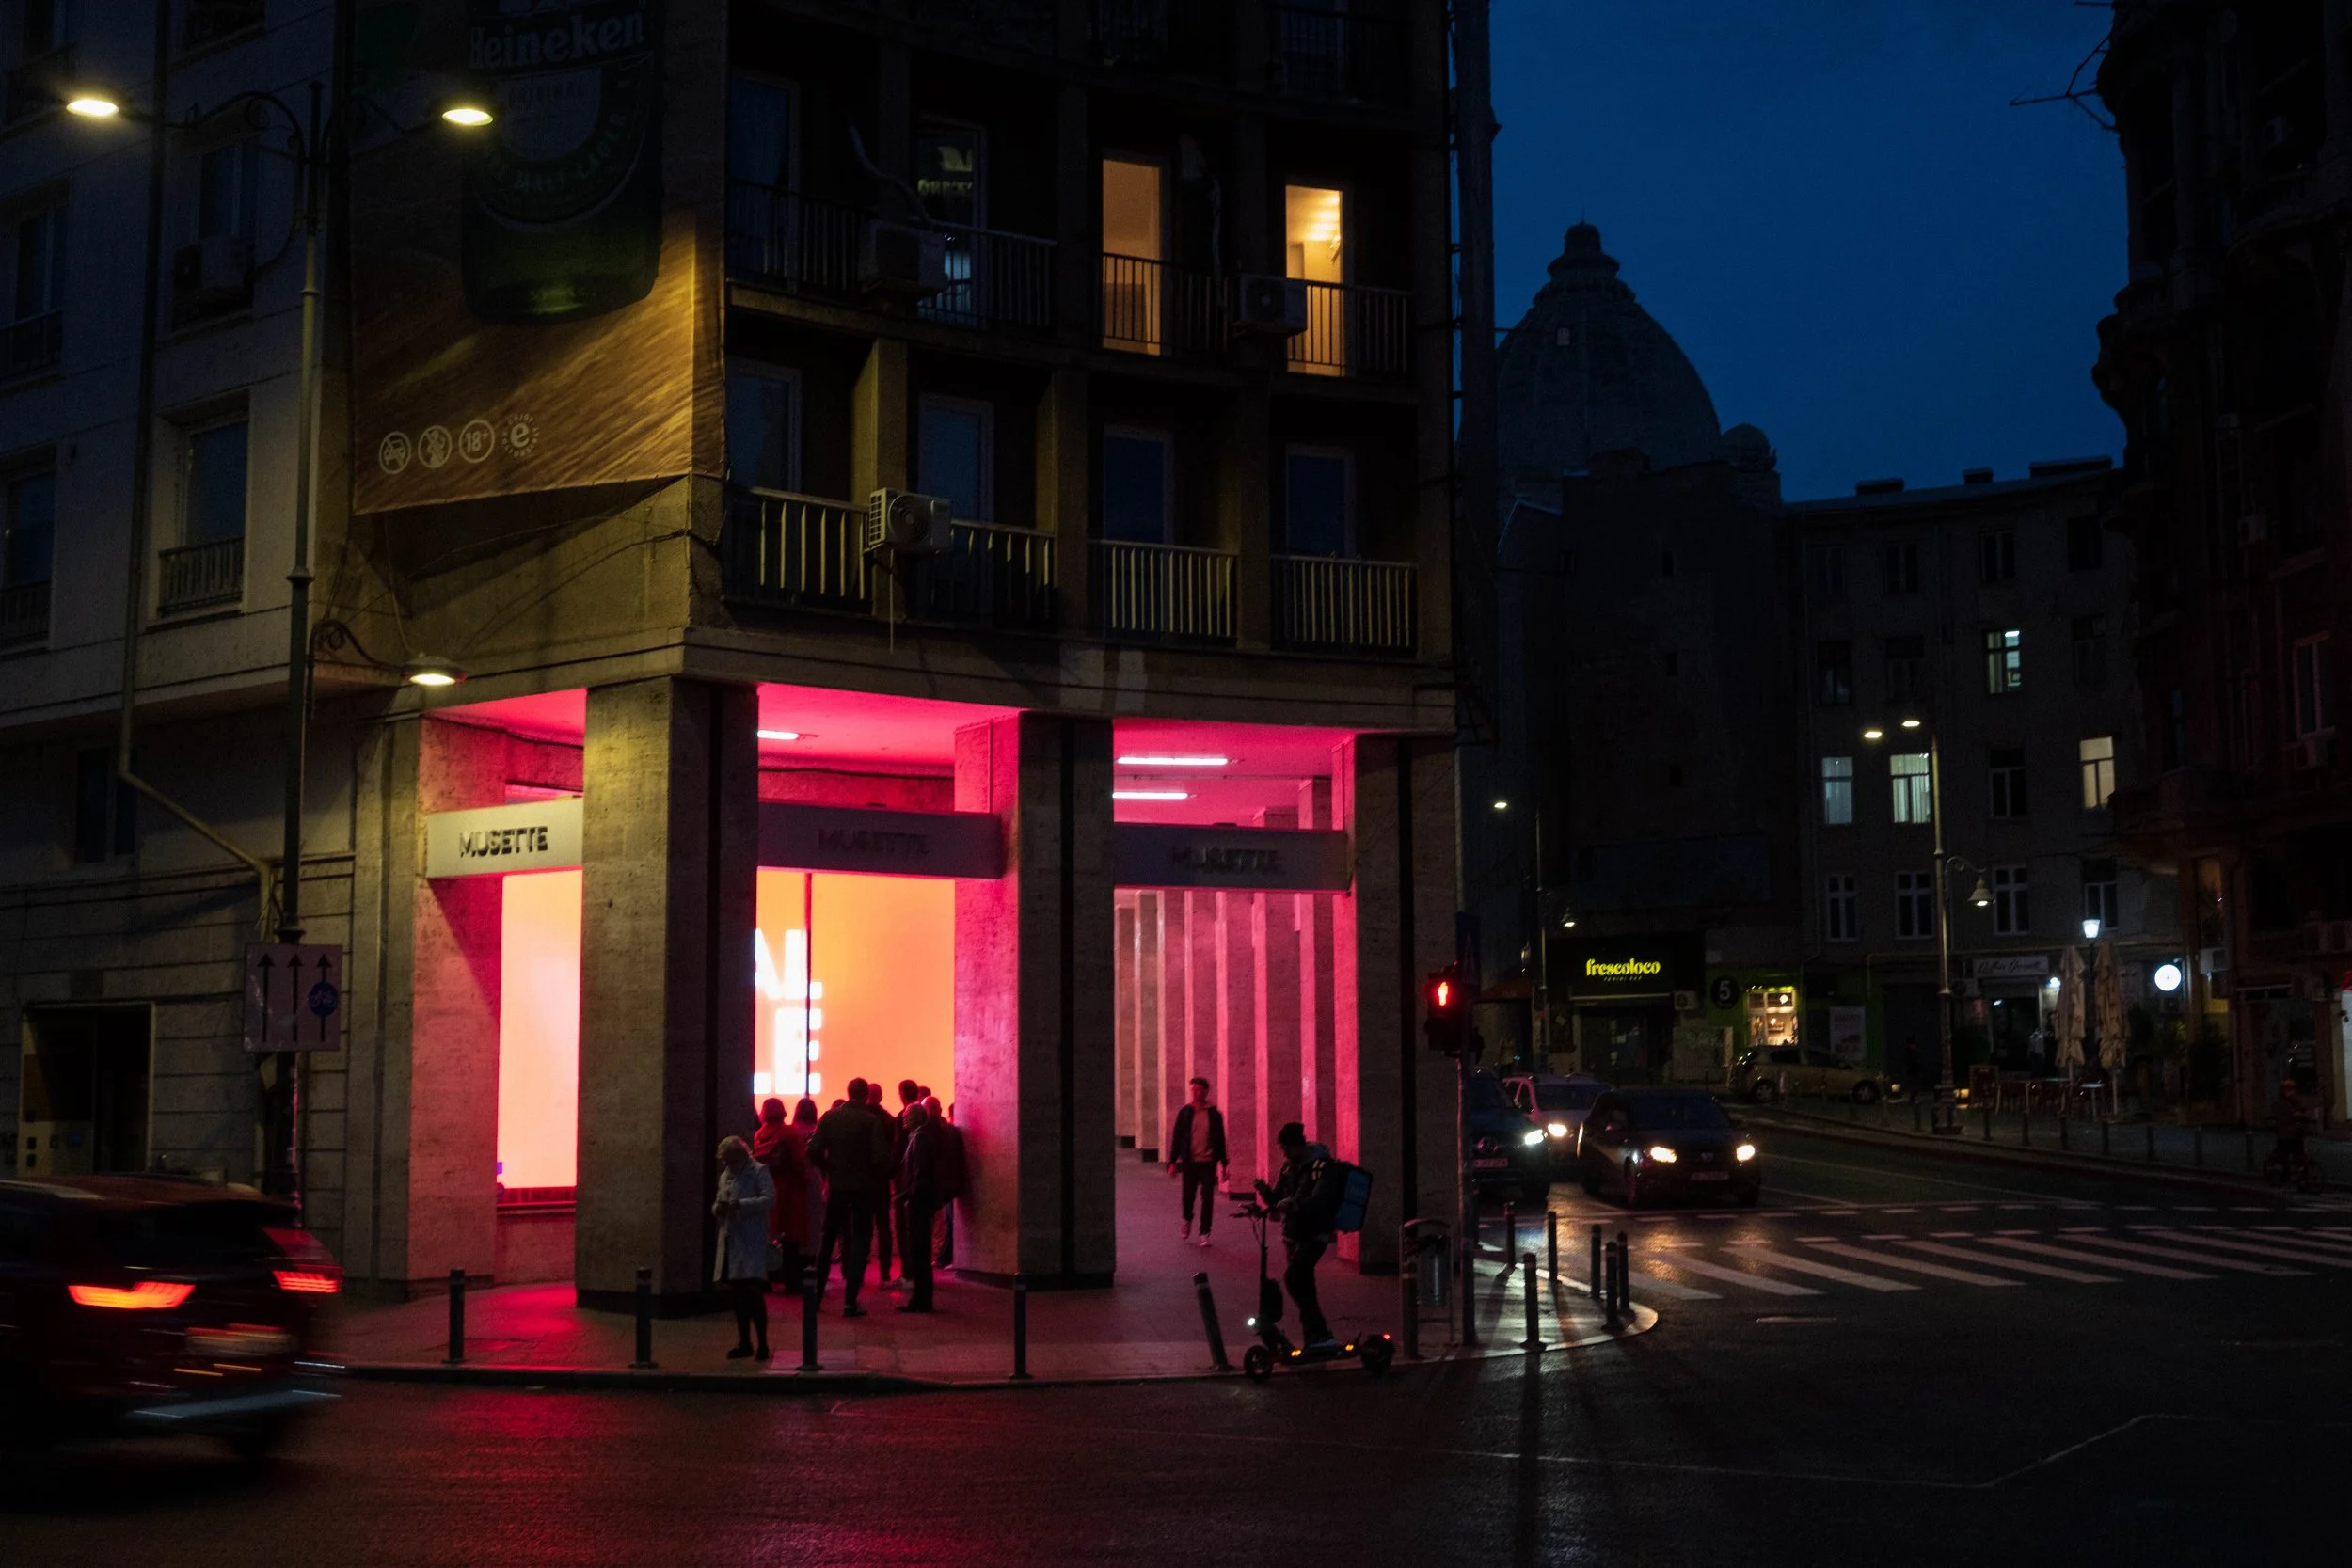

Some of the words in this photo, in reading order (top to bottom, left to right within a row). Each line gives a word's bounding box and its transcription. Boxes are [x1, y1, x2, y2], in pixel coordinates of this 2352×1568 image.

[470, 10, 644, 70] Heineken
[459, 826, 548, 857] MUSETTE
[1585, 957, 1661, 976] frescoloco
[1718, 979, 1733, 1002] 5
